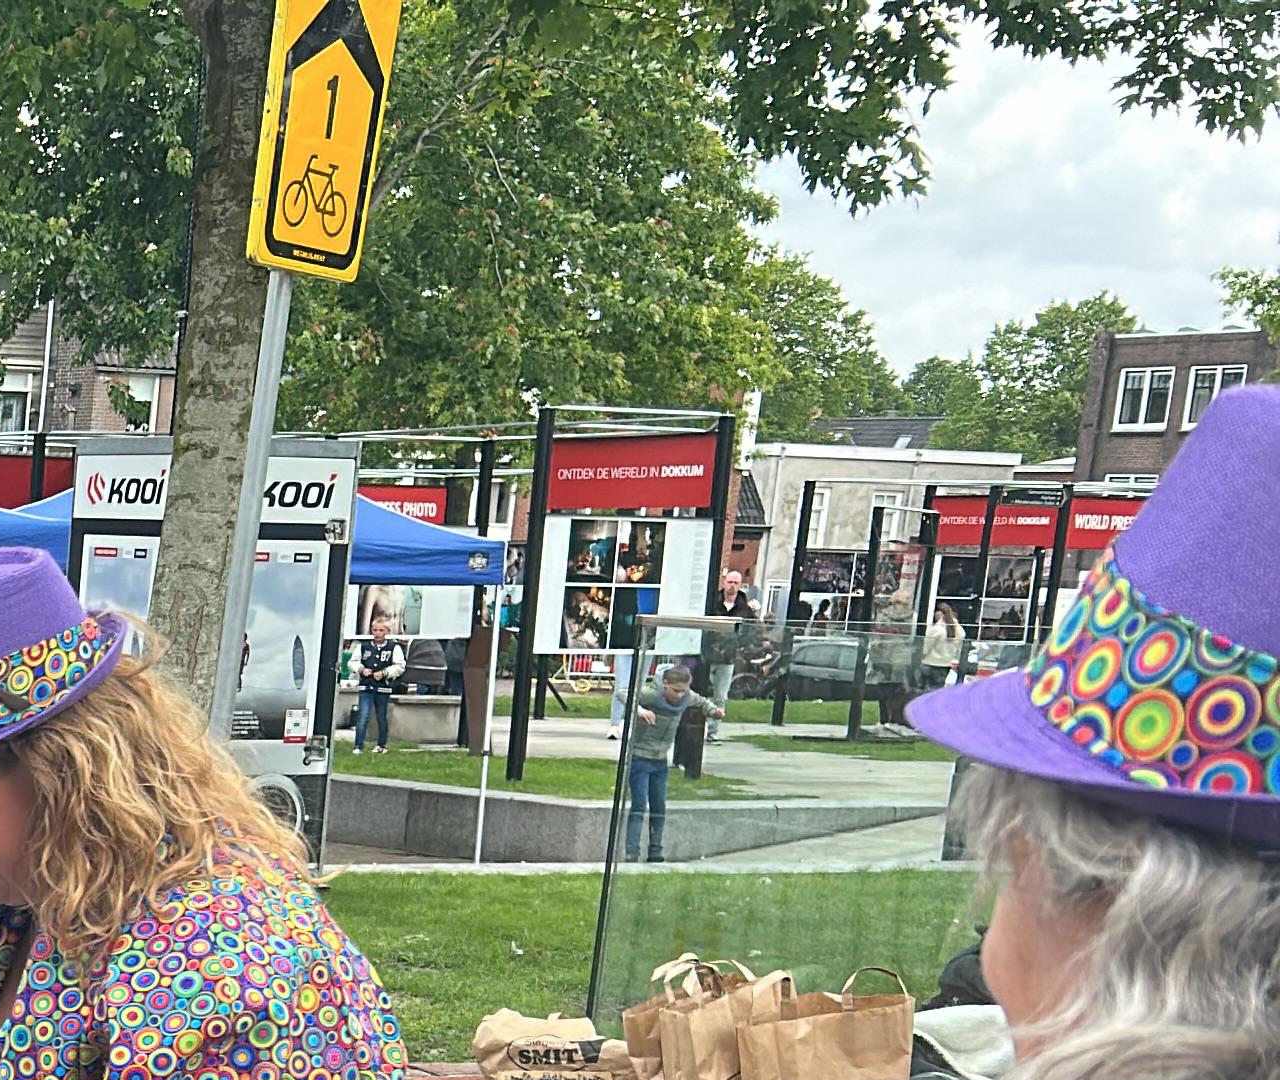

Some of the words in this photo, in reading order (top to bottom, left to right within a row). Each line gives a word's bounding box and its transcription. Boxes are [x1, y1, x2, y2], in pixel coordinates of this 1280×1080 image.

[325, 74, 339, 140] 1
[557, 468, 595, 480] ONTDEK
[596, 468, 609, 480] DE
[610, 466, 647, 479] WERELD
[648, 466, 659, 478] IN
[660, 464, 704, 478] DOKKUM
[402, 502, 437, 518] PHOTO
[939, 516, 968, 525] ONTDEK
[1074, 514, 1109, 530] WORLD
[380, 650, 392, 662] 87
[518, 1048, 579, 1066] SMIT
